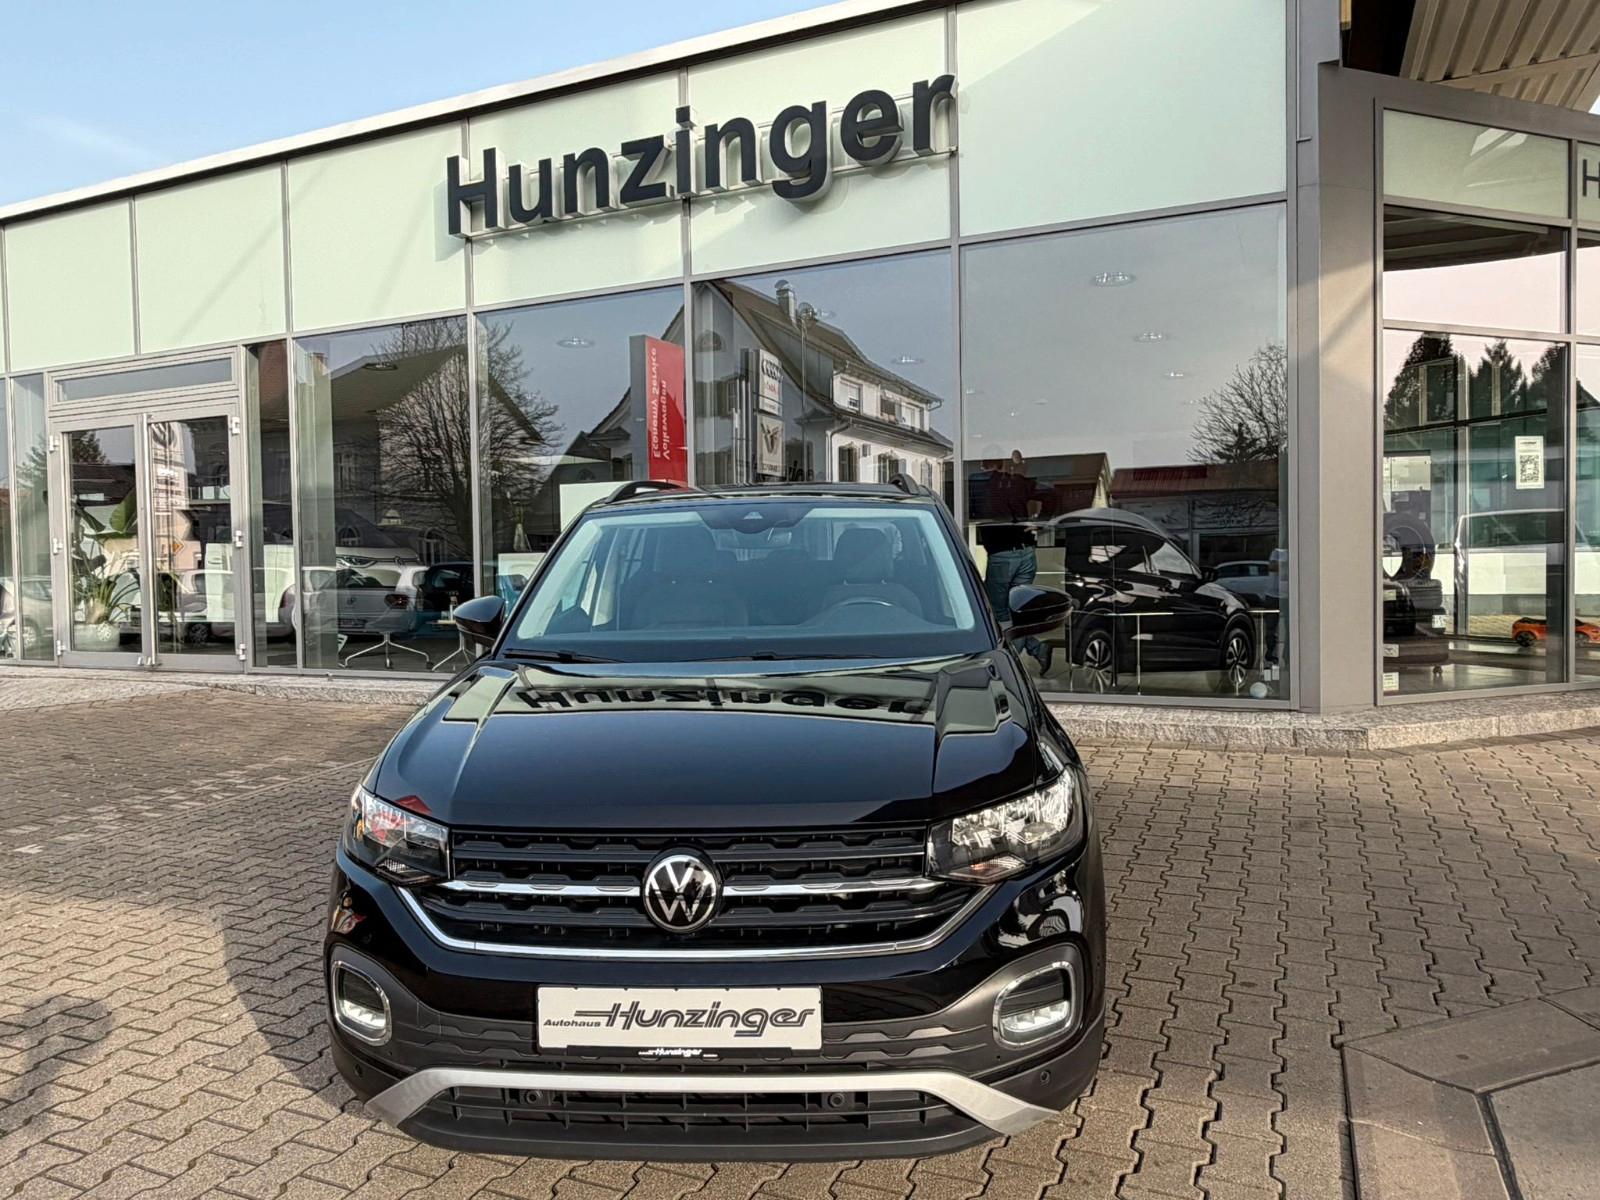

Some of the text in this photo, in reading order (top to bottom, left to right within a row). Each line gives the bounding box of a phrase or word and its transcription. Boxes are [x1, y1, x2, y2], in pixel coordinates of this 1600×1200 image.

[446, 73, 957, 238] Hunzinger
[543, 1000, 816, 1038] Autohaus Hunzinger
